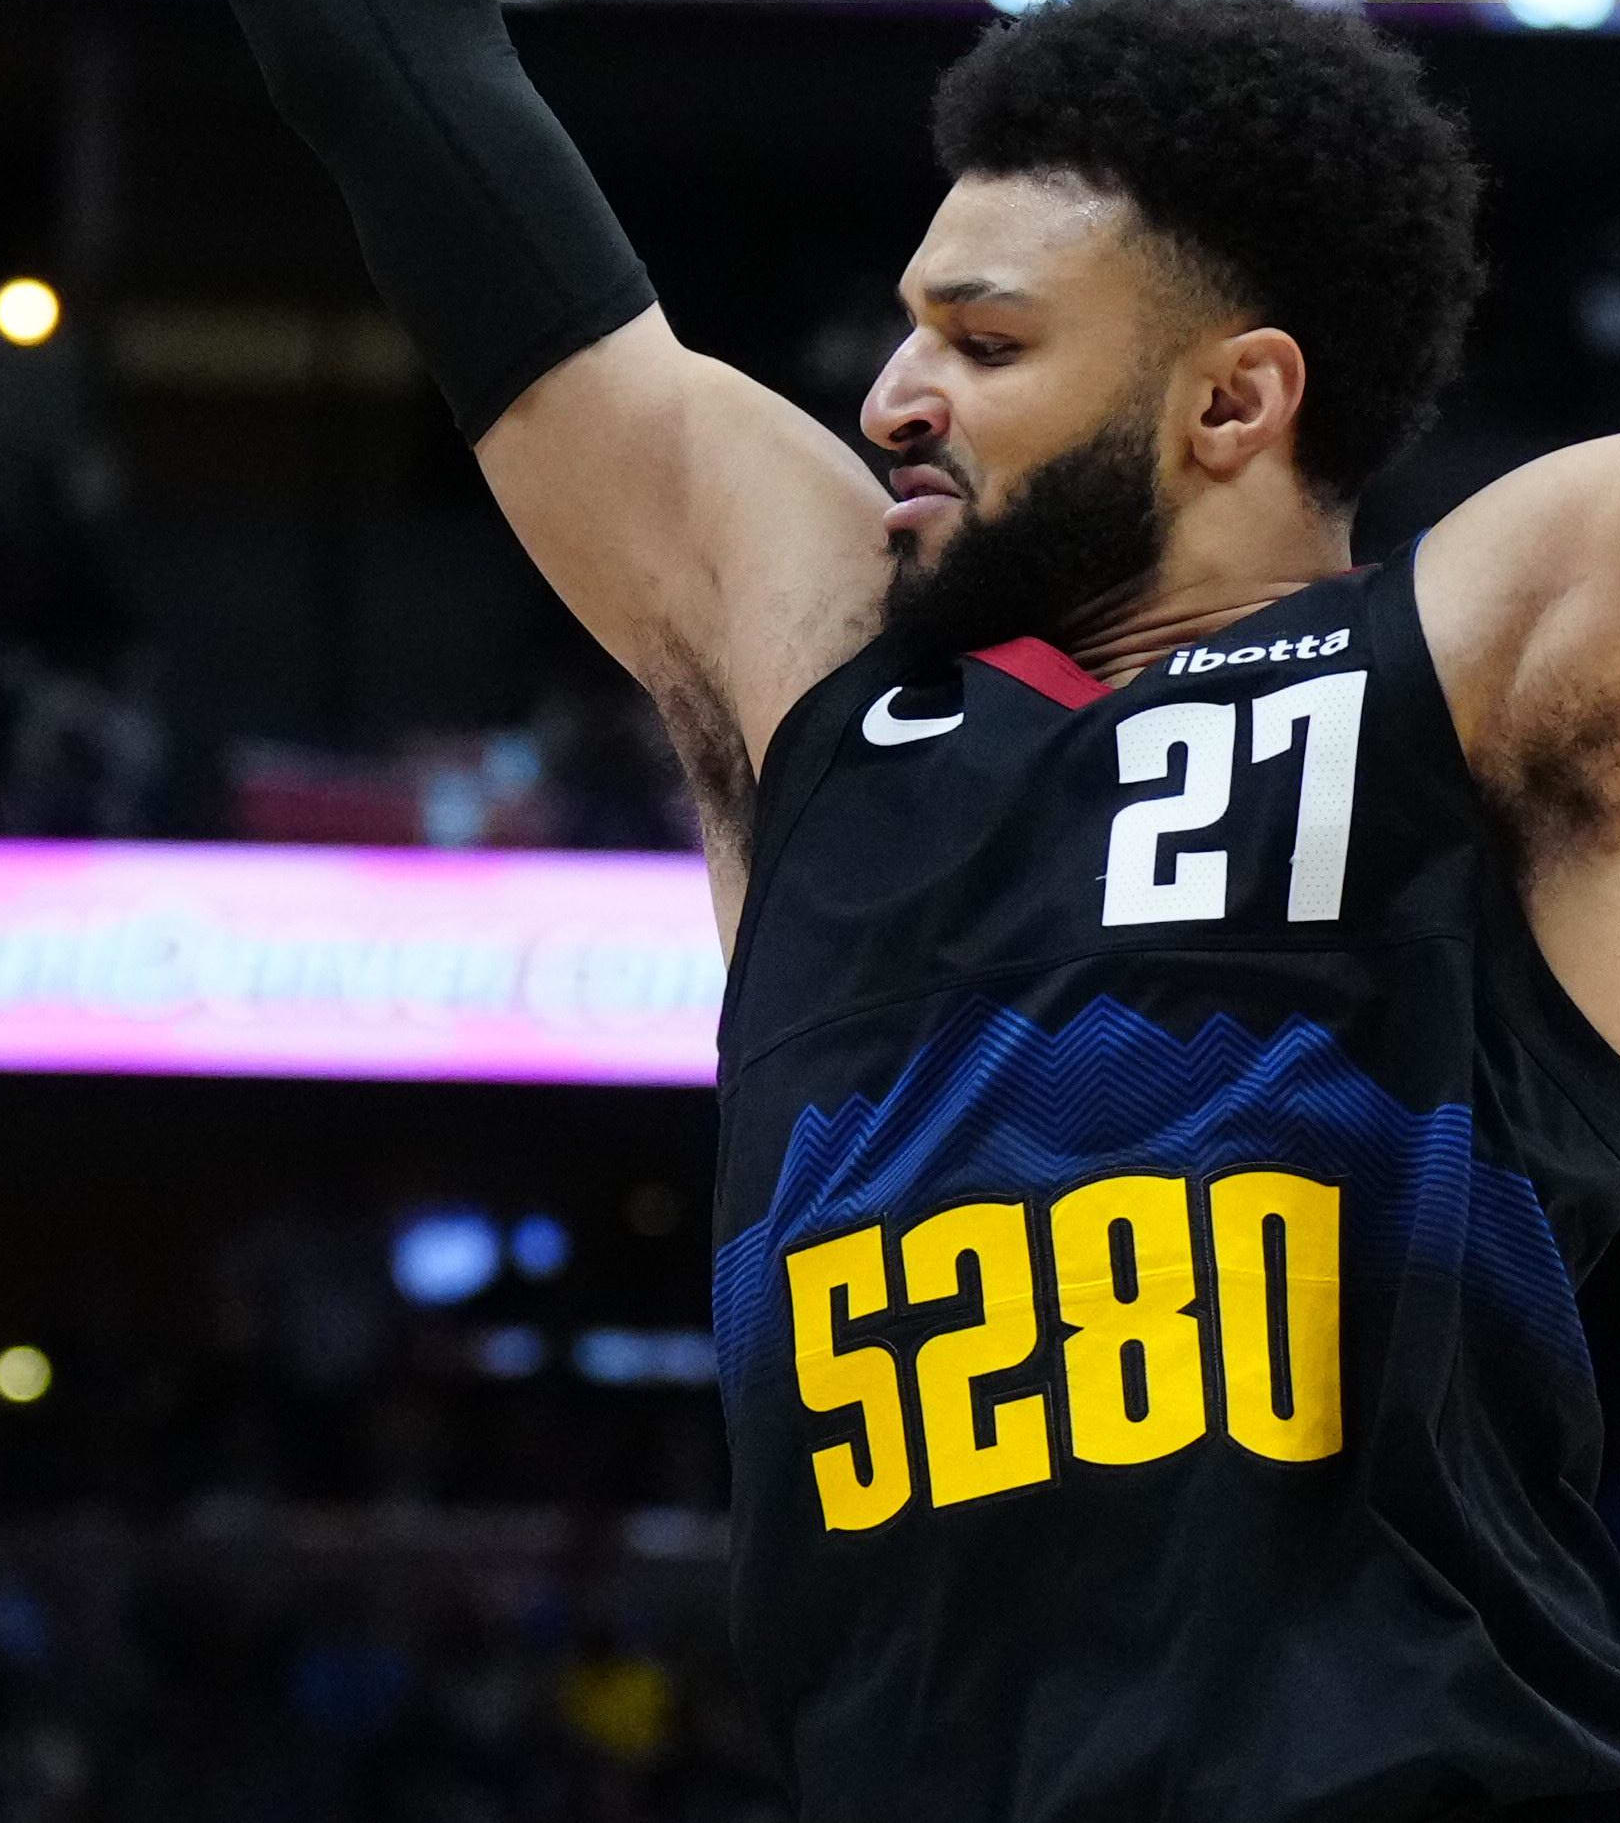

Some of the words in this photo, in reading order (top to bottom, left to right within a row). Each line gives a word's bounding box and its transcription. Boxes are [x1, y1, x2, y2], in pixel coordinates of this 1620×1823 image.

[1168, 628, 1350, 676] ibotta
[1101, 670, 1368, 928] 27
[785, 1170, 1343, 1532] 5280
